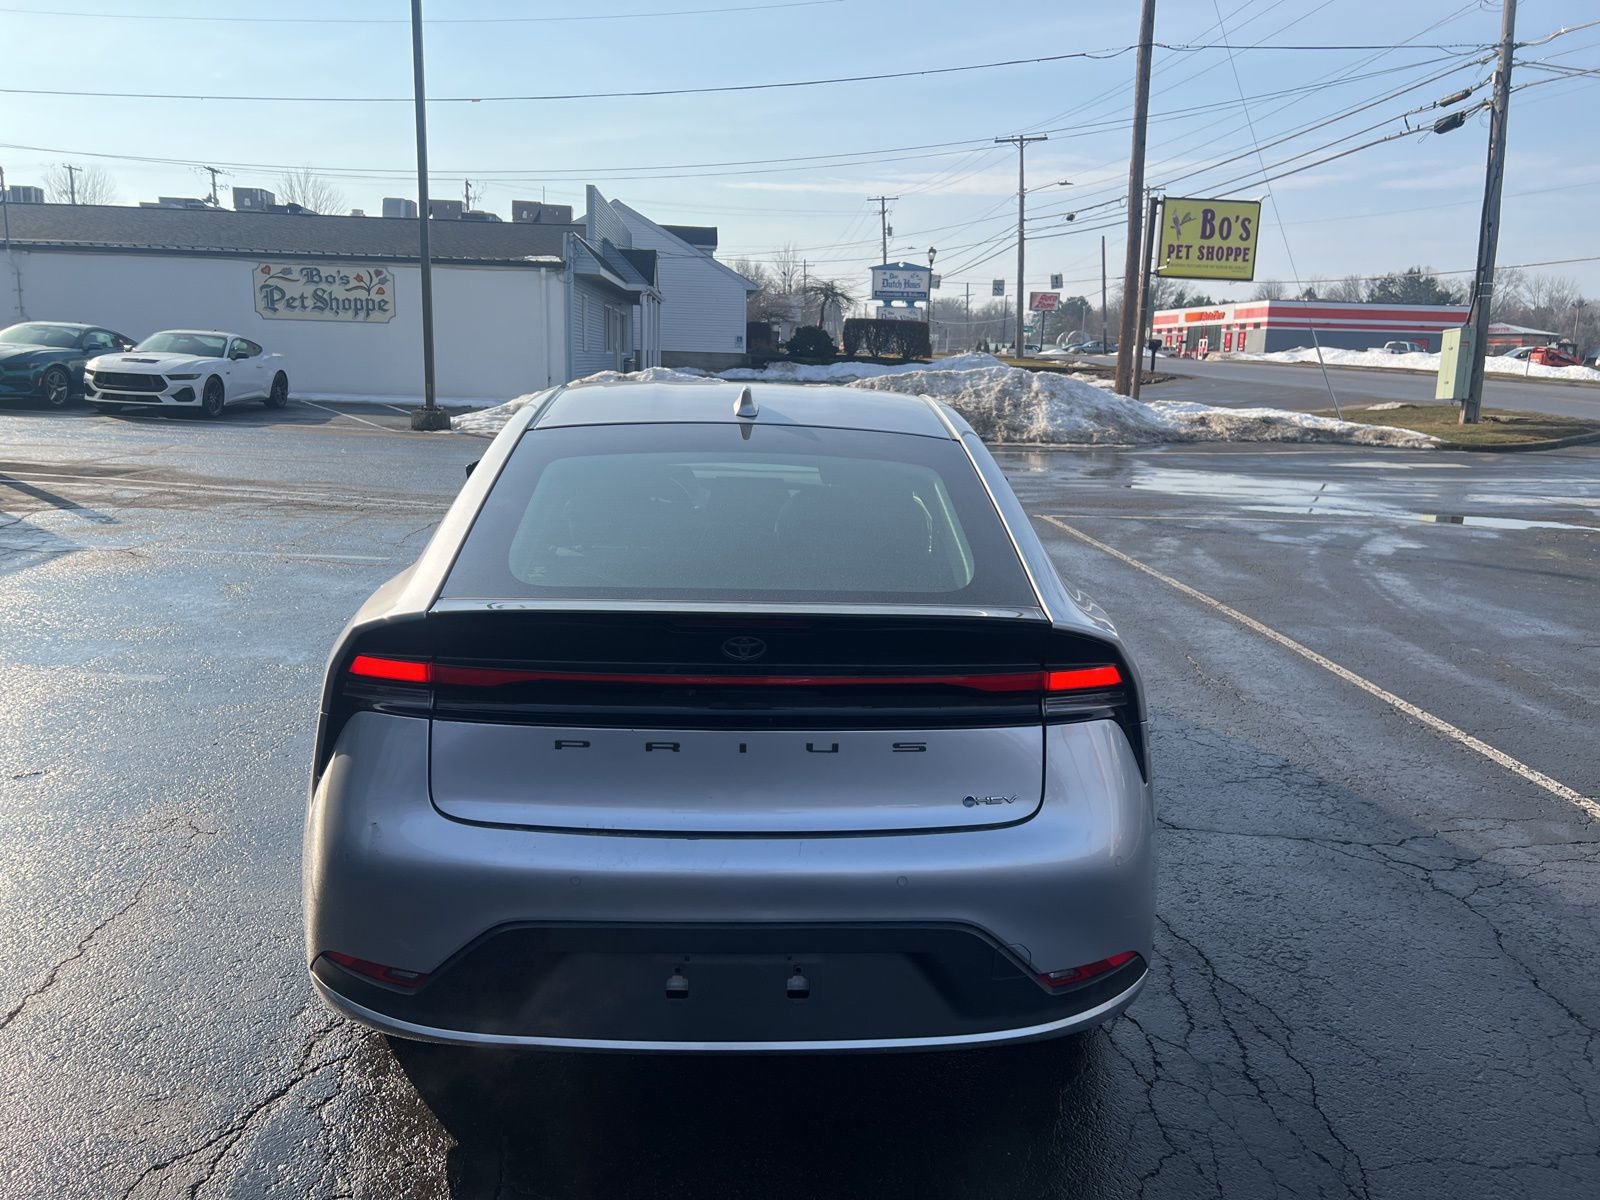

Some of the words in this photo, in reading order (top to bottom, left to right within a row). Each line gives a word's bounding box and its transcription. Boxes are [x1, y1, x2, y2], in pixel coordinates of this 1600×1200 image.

[1200, 208, 1252, 242] BO'S
[1167, 244, 1193, 260] PET
[1197, 245, 1250, 262] SHOPPE
[300, 267, 350, 286] Bo's
[882, 278, 902, 290] Dutch
[260, 284, 309, 313] Pet
[311, 287, 390, 319] Shoppe
[555, 740, 927, 753] PRIUS
[975, 794, 1018, 806] HEV
